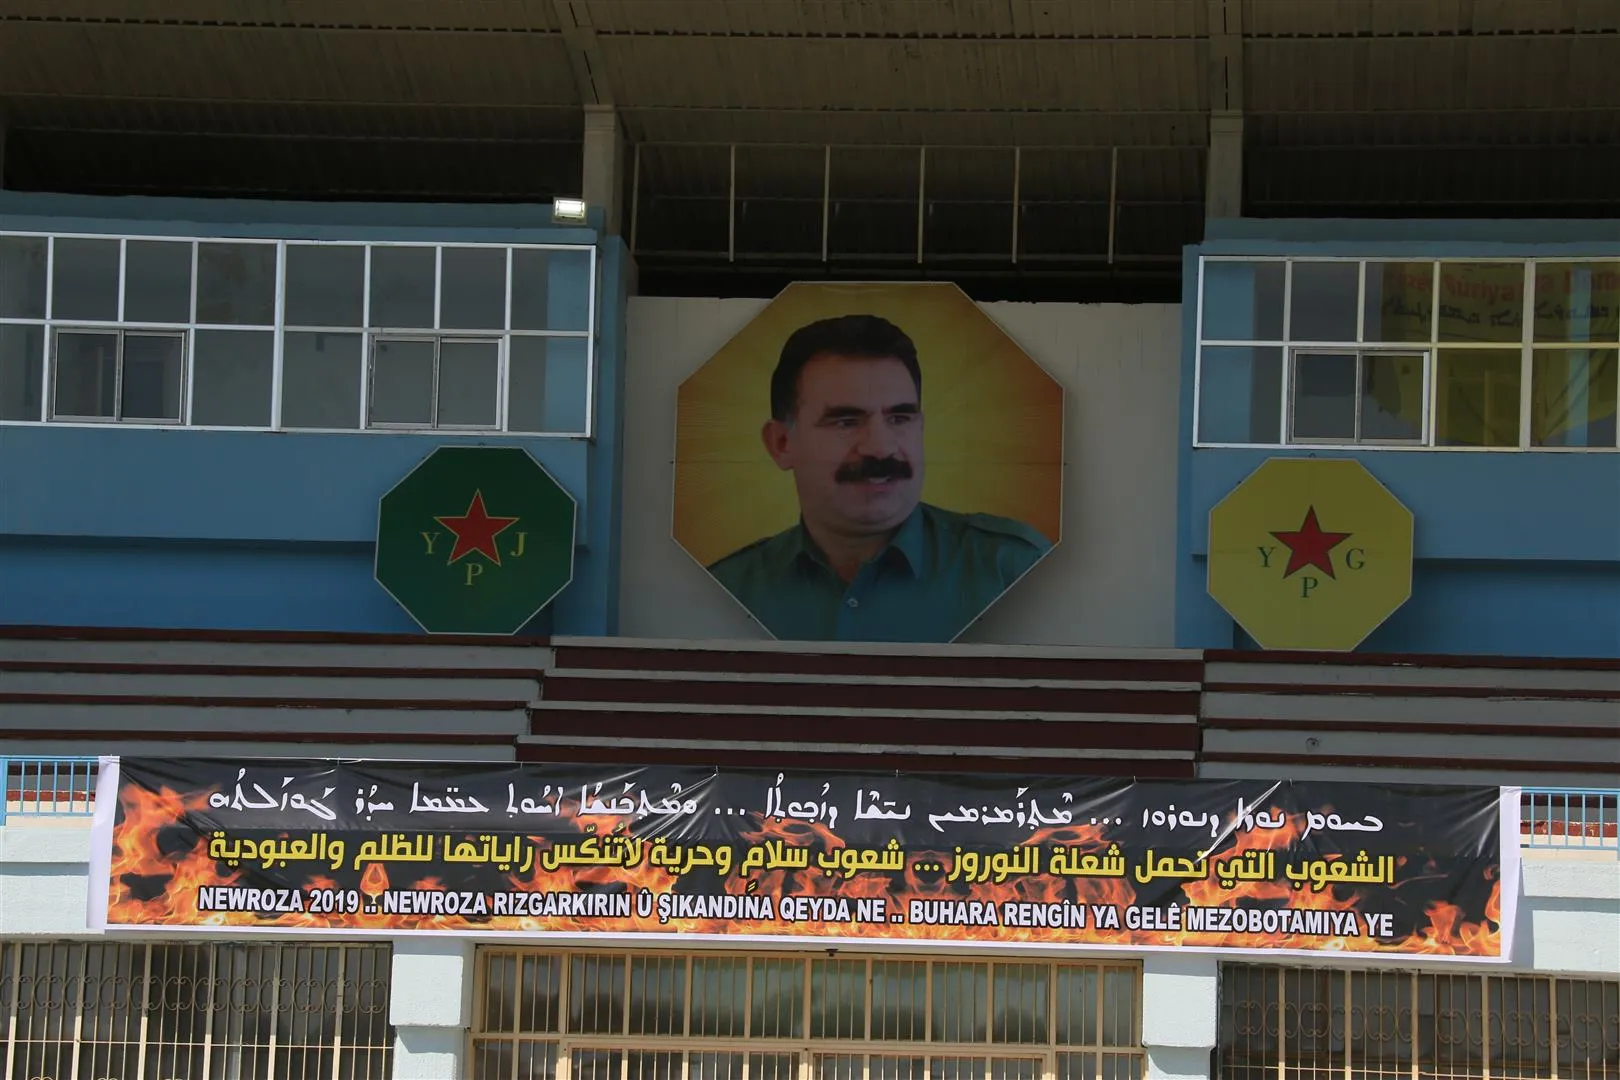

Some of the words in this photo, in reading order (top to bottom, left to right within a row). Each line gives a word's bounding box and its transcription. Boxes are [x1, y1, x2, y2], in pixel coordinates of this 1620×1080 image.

[420, 532, 440, 554] Y
[465, 563, 483, 585] P
[510, 532, 527, 556] J
[1257, 547, 1276, 568] Y
[1301, 577, 1318, 598] P
[1345, 549, 1365, 570] G
[210, 831, 345, 870] والعبودية
[354, 833, 433, 870] للظلم
[444, 833, 533, 872] راياتها
[651, 836, 732, 875] وحرية
[817, 839, 904, 878] شعوب
[948, 846, 1039, 882] النوروز
[1050, 844, 1125, 877] شعلة
[1135, 850, 1207, 884] تحمل
[1217, 851, 1274, 887] التي
[1286, 850, 1394, 890] الشعوب
[199, 887, 303, 912] NEWROZA
[309, 890, 359, 913] 2019
[384, 890, 487, 915] NEWROZA
[493, 893, 630, 916] RIZGARKIRIN
[638, 889, 651, 916] Û
[780, 896, 850, 922] QEYDA
[857, 899, 885, 922] NE
[910, 900, 997, 925] BUHARA
[1004, 899, 1085, 928] RENGÎN
[1093, 904, 1119, 929] YA
[1125, 903, 1181, 931] GELÊ
[1187, 907, 1359, 937] MEZOBOTAMIYA
[1364, 913, 1393, 937] YE
